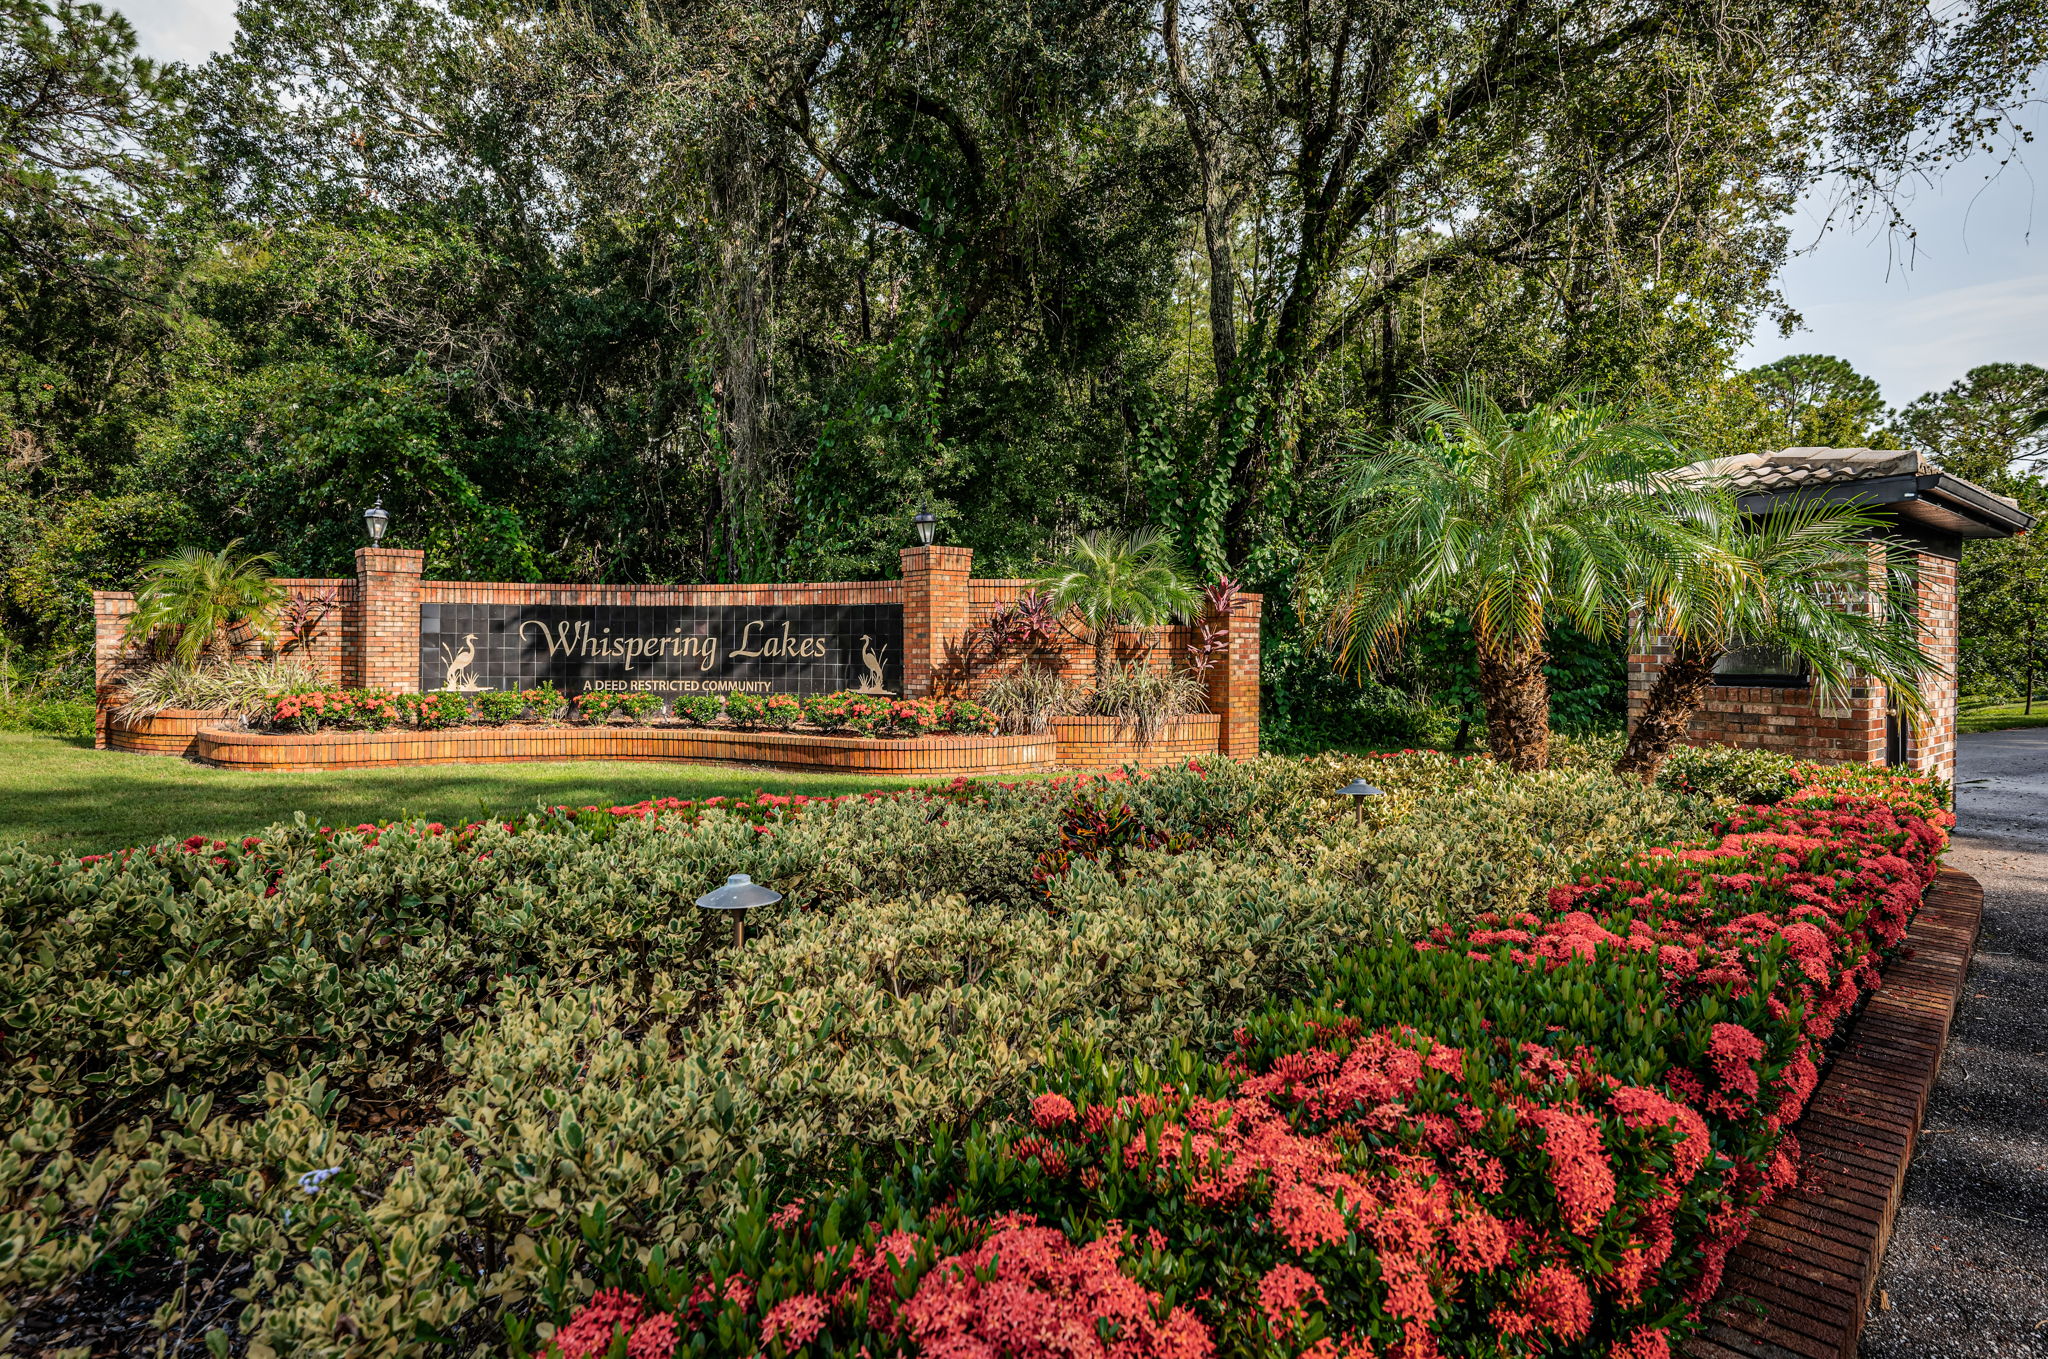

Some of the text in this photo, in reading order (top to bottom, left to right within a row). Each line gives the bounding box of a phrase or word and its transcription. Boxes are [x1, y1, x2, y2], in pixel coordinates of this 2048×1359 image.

[519, 620, 827, 671] Whispering Lakes
[583, 680, 772, 692] A DEED RESTRICTED COMMUNITY
